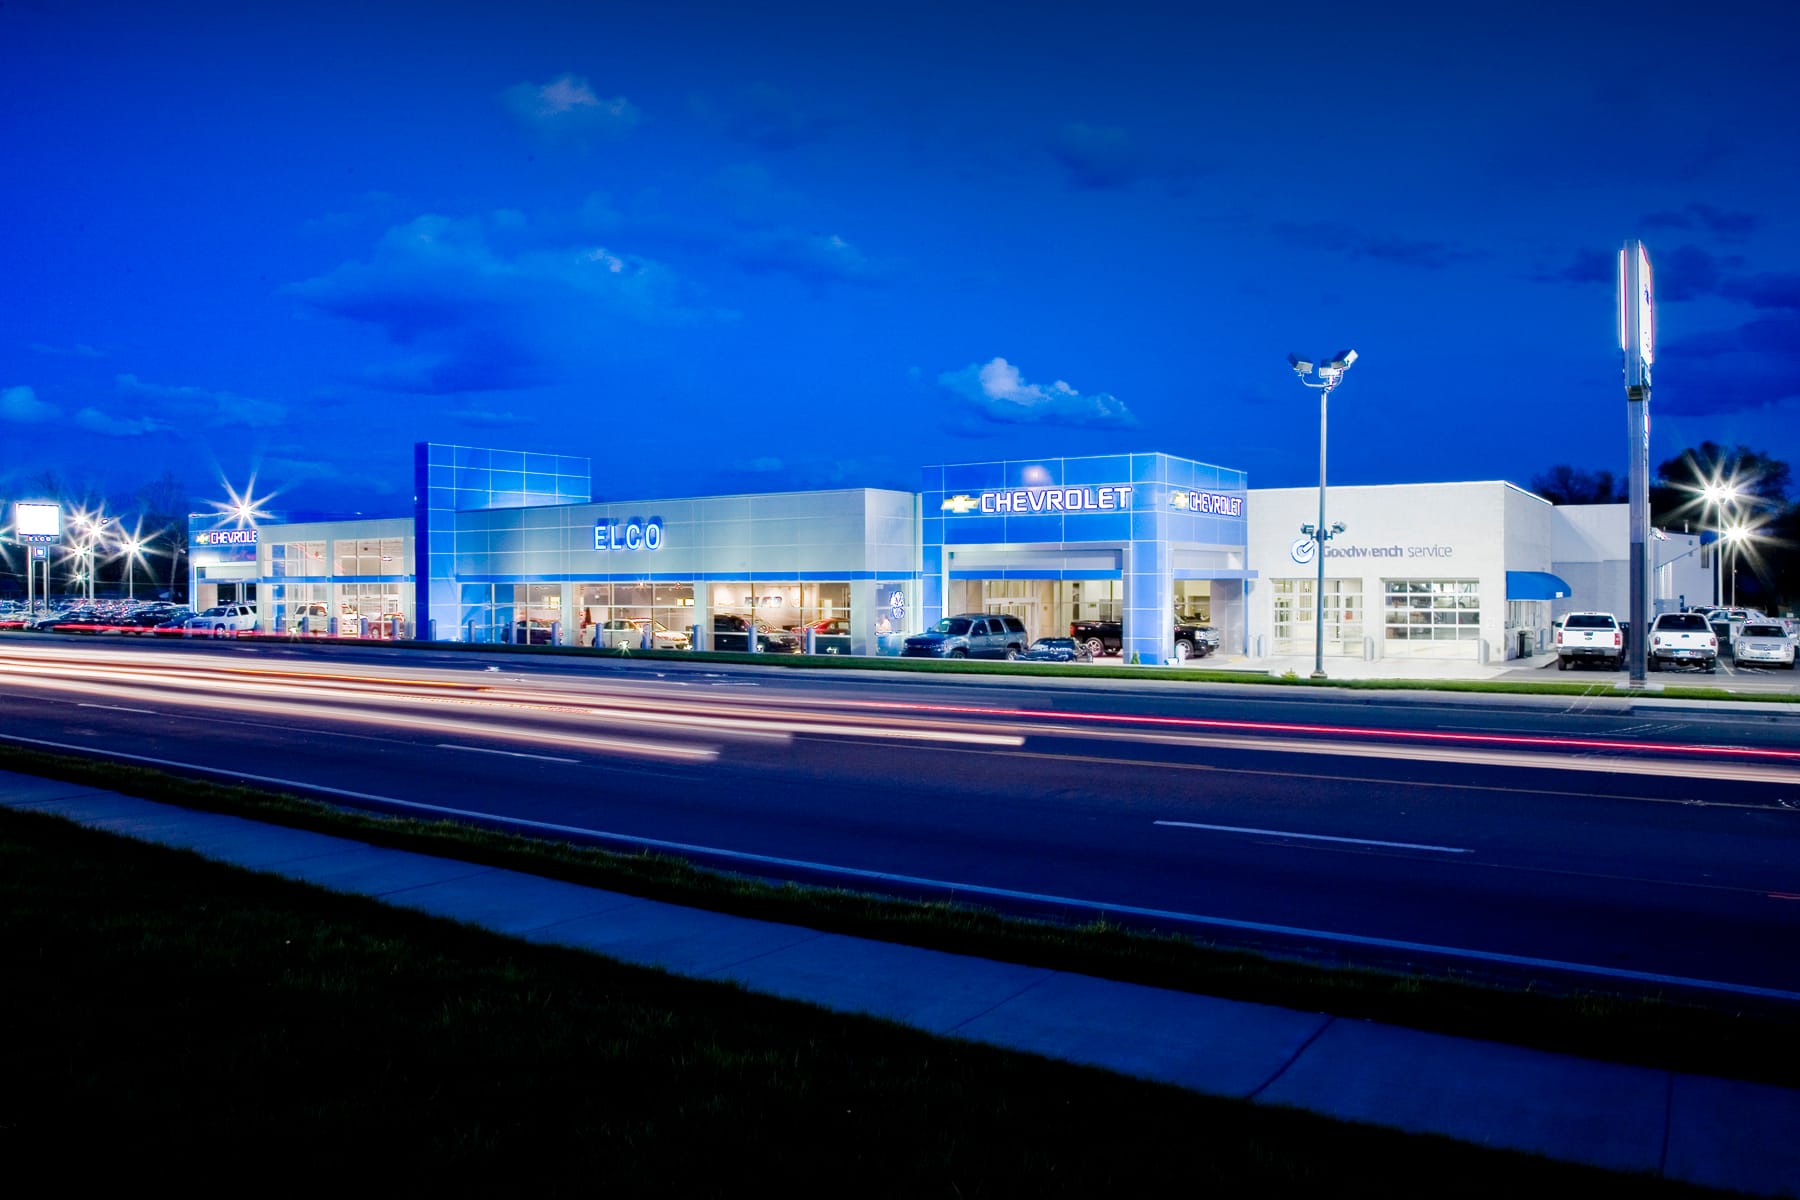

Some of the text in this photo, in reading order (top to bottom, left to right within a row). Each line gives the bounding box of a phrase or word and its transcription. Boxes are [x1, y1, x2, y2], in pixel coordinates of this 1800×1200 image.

[981, 487, 1132, 513] CHEVROLET
[1188, 490, 1243, 517] CHEVROLET
[210, 530, 257, 544] CHEVROLE
[594, 523, 661, 550] ELCO
[1407, 544, 1453, 558] service
